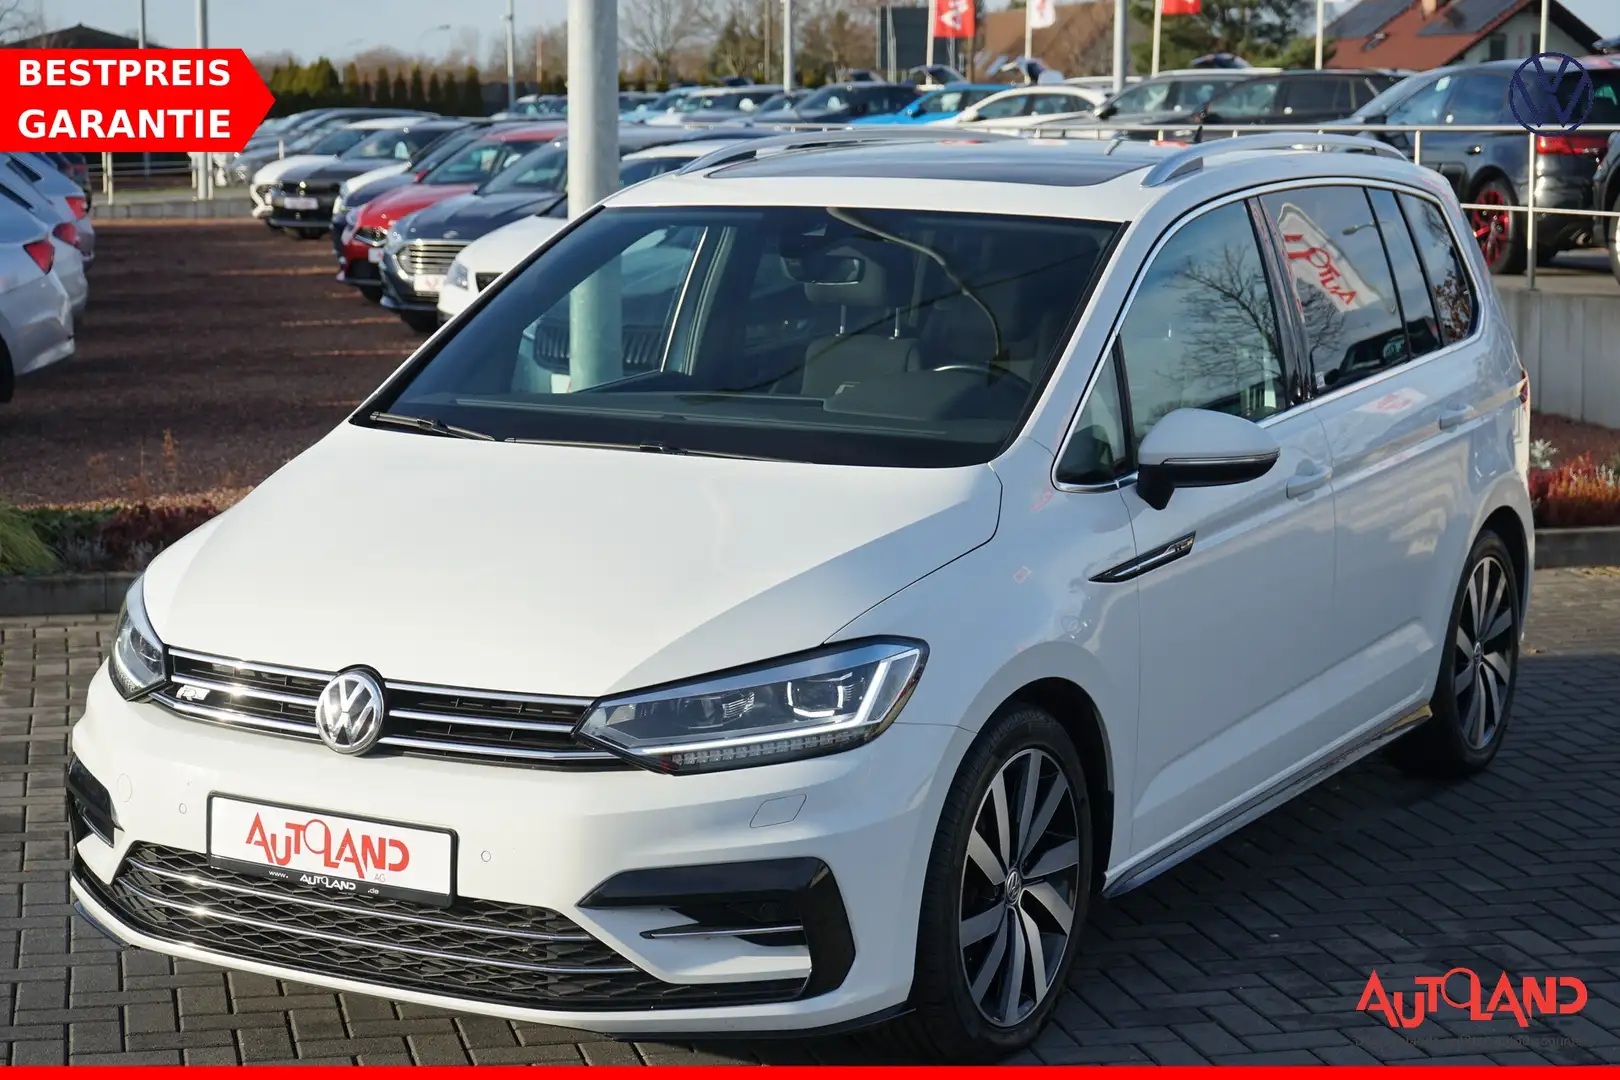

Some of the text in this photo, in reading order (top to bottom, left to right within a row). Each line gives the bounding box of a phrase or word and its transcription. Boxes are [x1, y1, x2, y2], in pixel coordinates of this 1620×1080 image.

[245, 812, 410, 879] AUTOLAND
[268, 870, 289, 879] www.
[299, 873, 357, 891] AUTOLAND
[374, 872, 386, 883] AG
